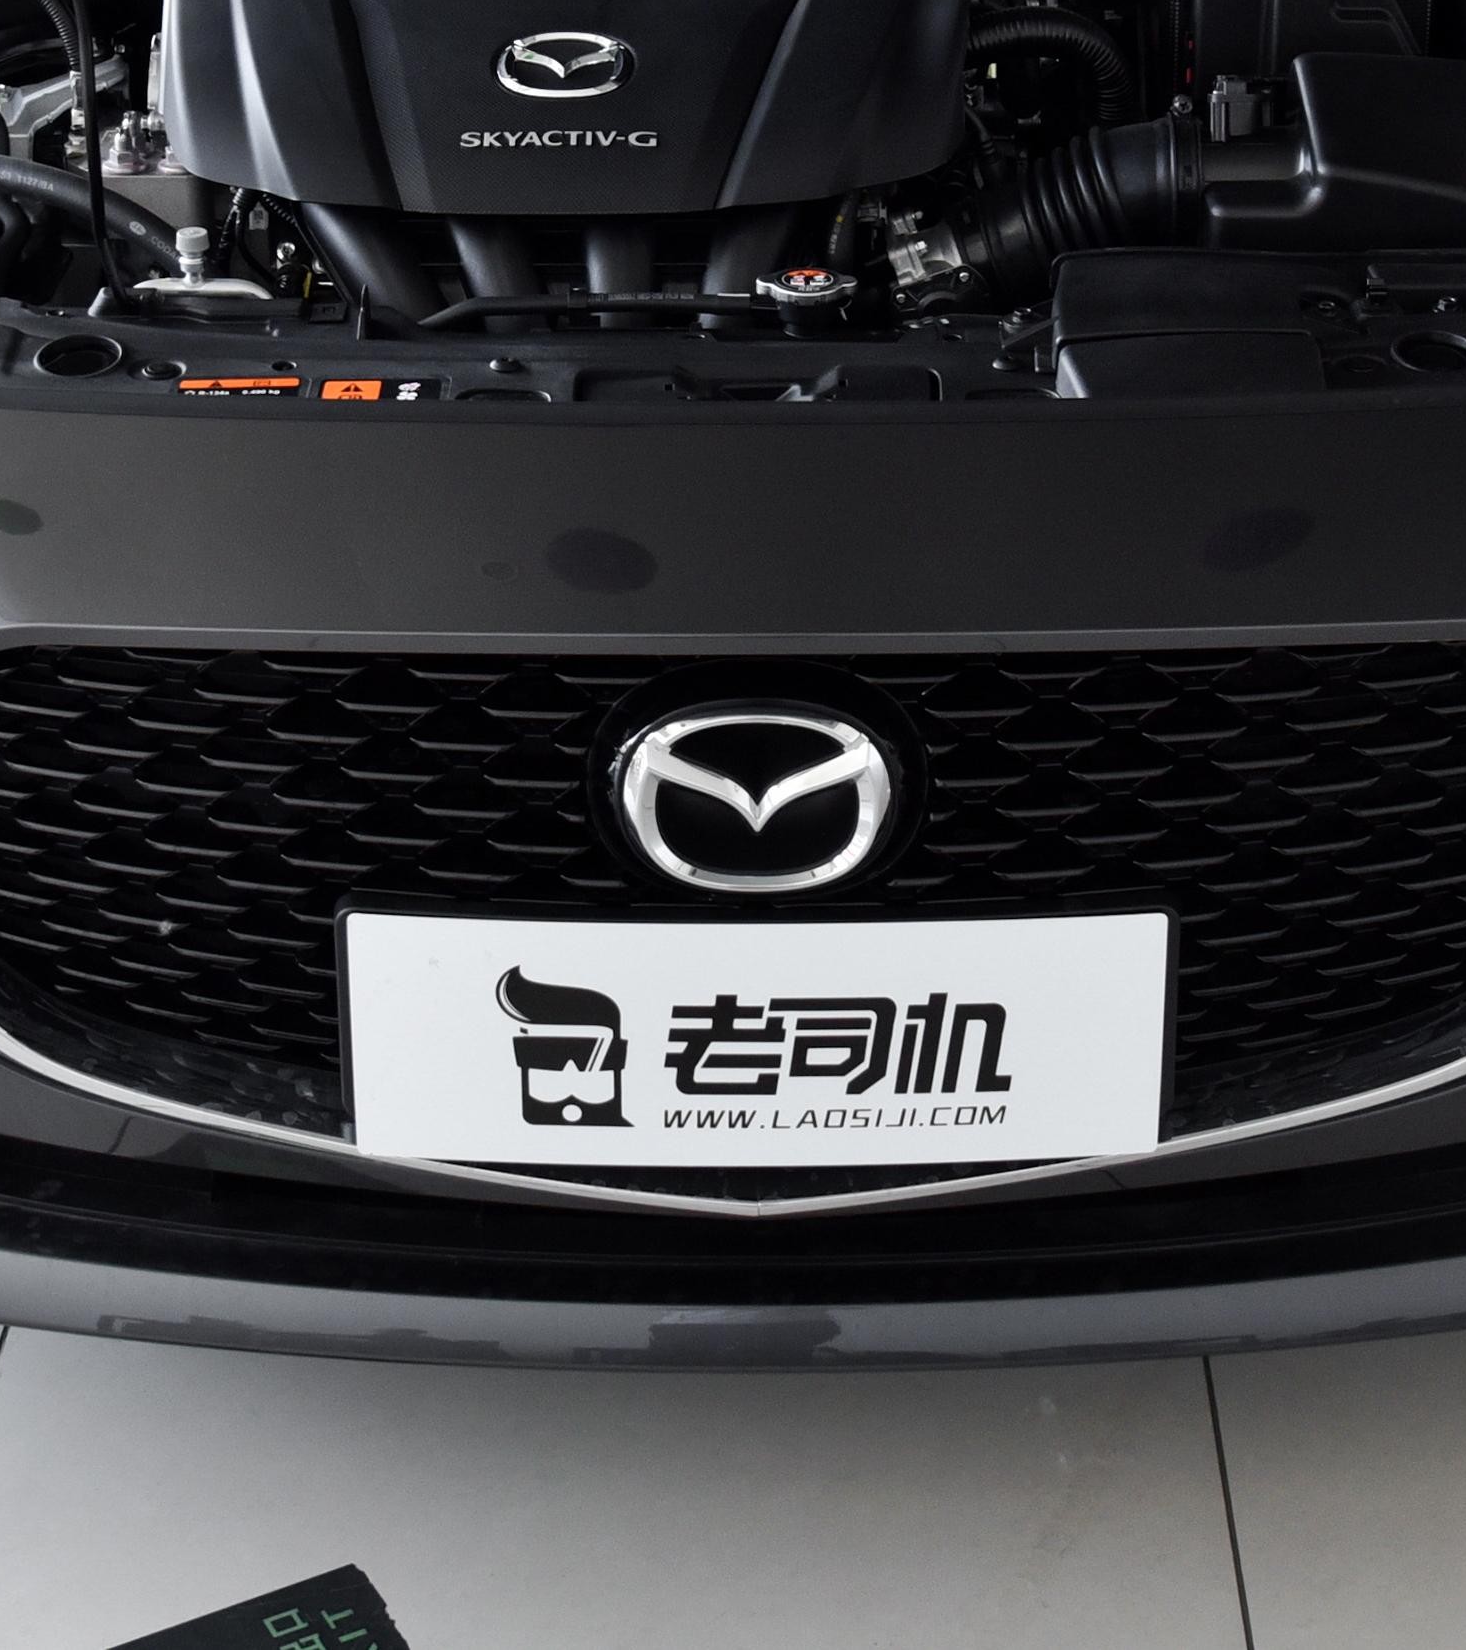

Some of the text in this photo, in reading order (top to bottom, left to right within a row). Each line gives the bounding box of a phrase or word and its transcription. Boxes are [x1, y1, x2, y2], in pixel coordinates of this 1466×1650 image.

[459, 129, 658, 148] SKYACTIV-G
[664, 992, 1012, 1096] 老司机
[663, 1105, 1008, 1129] WWW.LAOSIJI.COM
